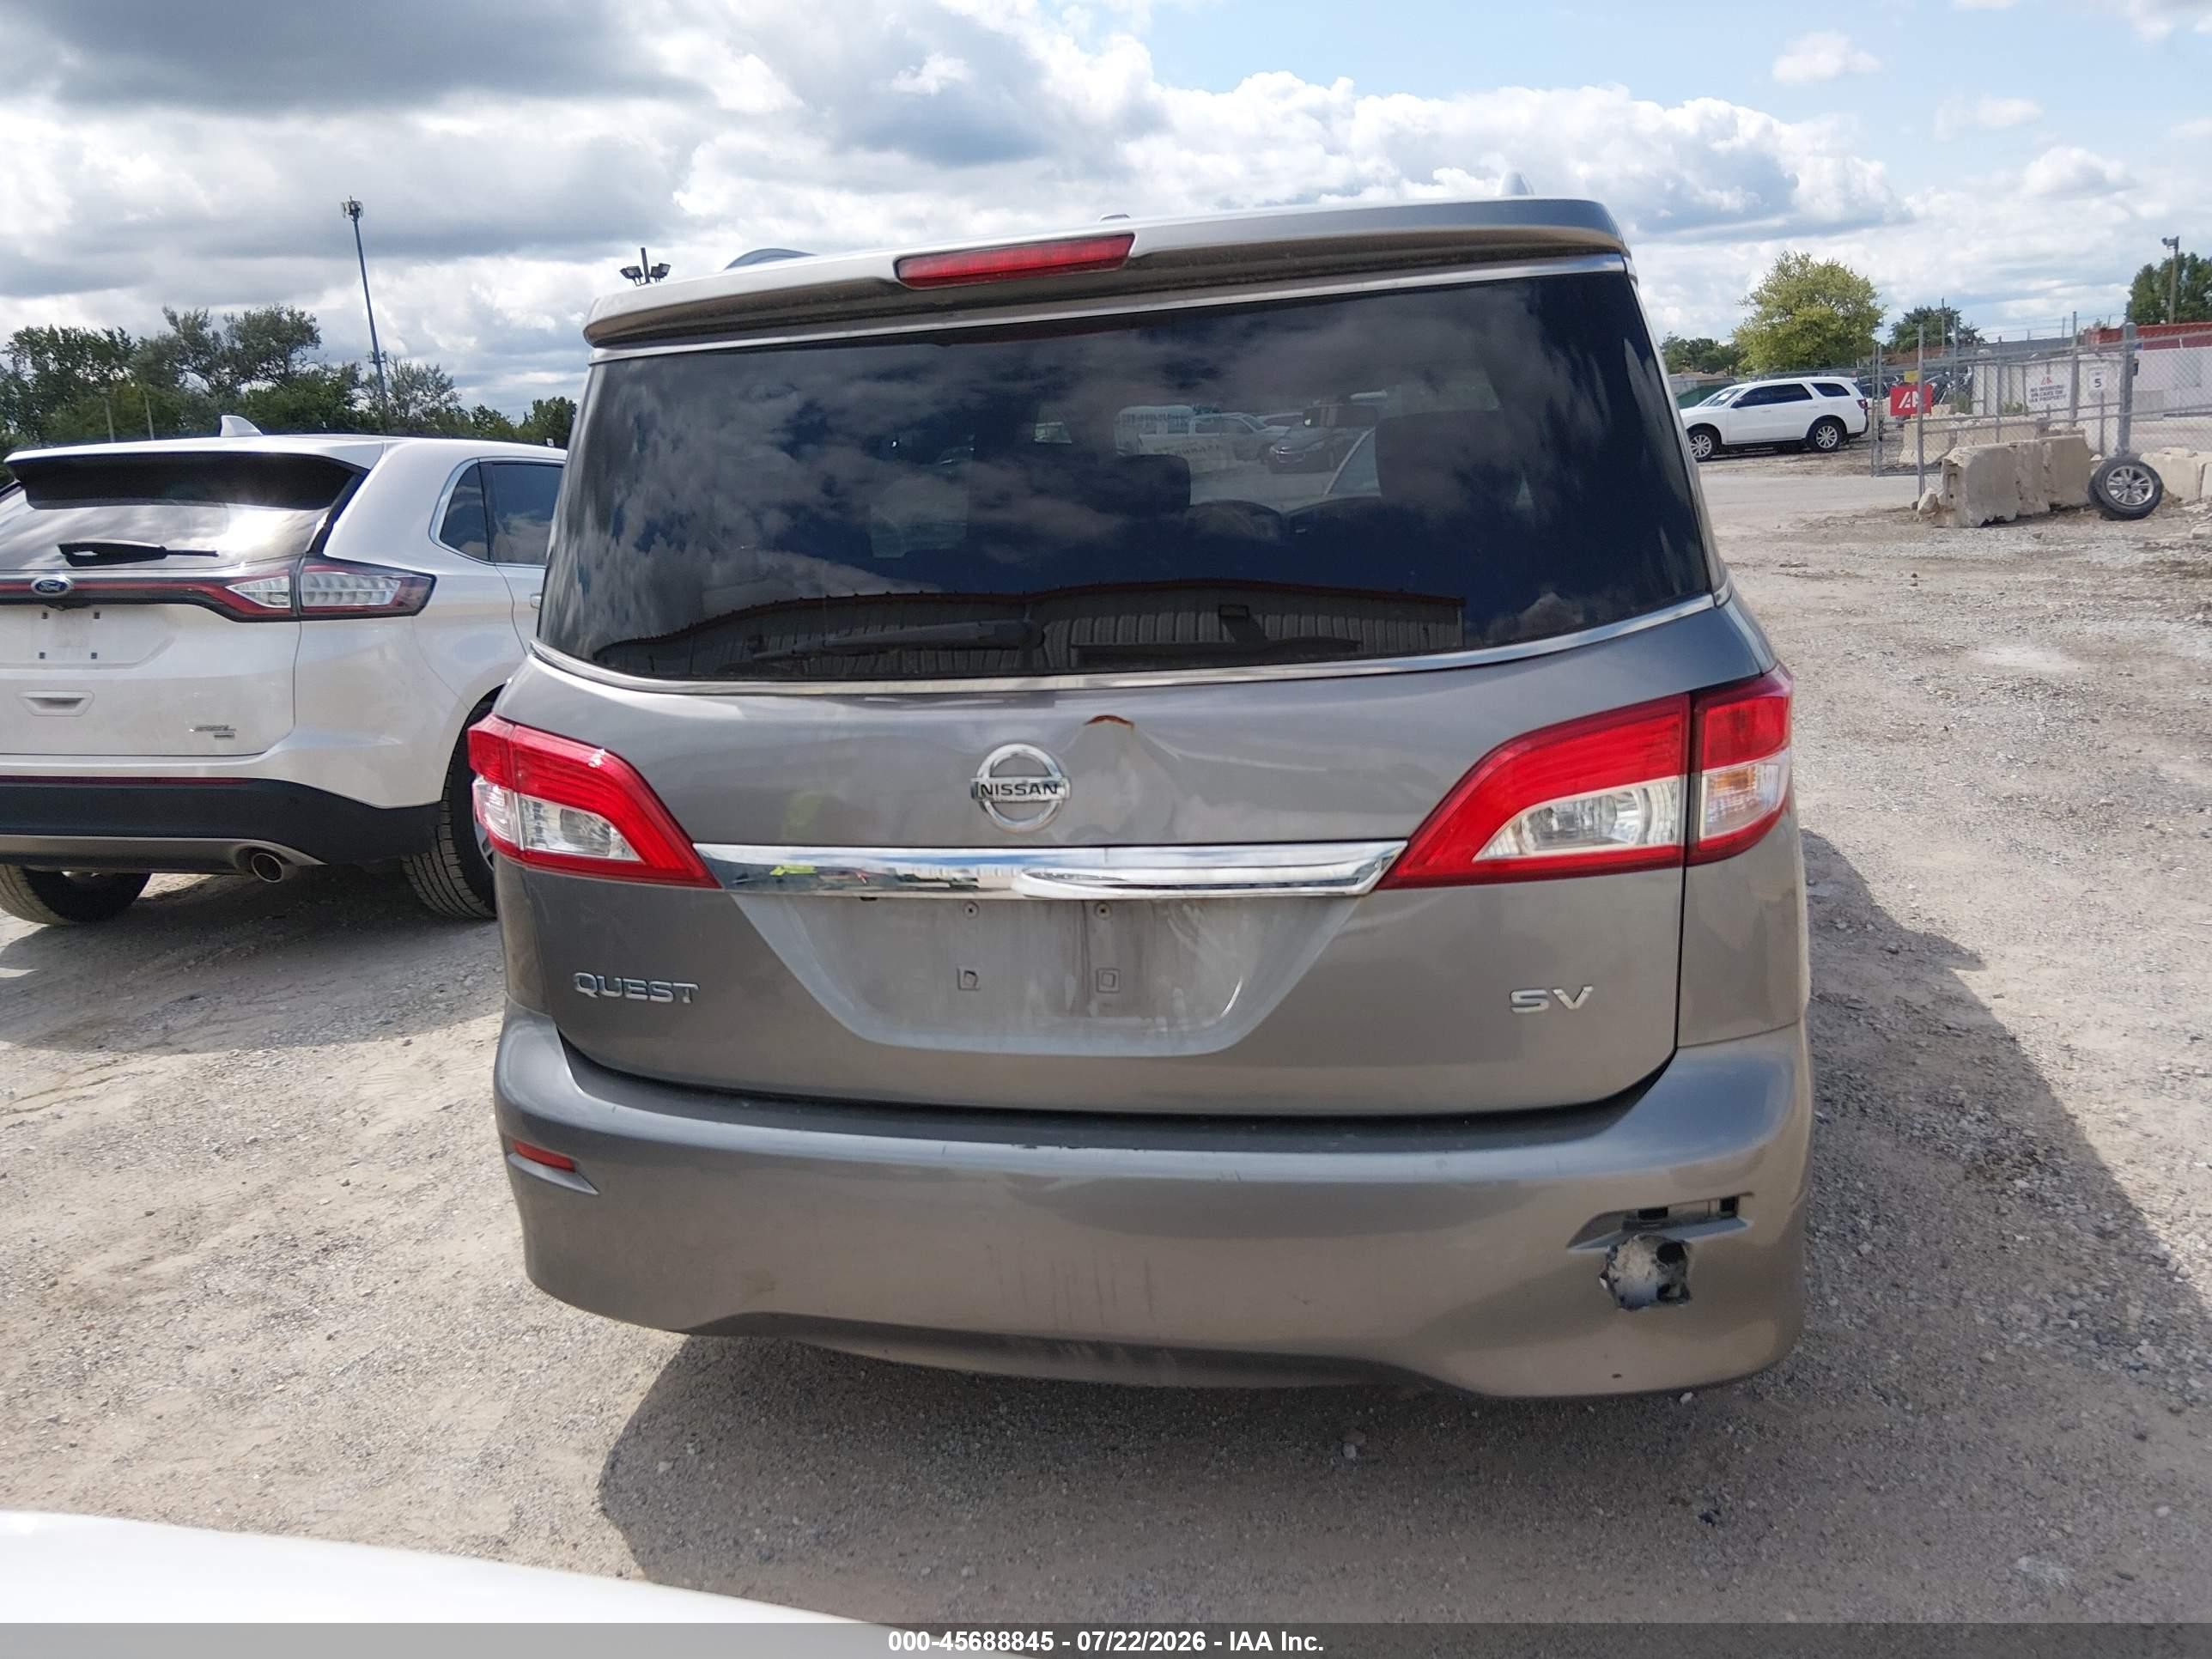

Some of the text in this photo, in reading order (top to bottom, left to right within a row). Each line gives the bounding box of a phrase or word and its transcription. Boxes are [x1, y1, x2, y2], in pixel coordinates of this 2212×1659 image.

[2094, 378, 2102, 388] 5
[980, 782, 1059, 797] NISSAN
[574, 971, 700, 1004] QUEST
[1510, 984, 1595, 1014] SV
